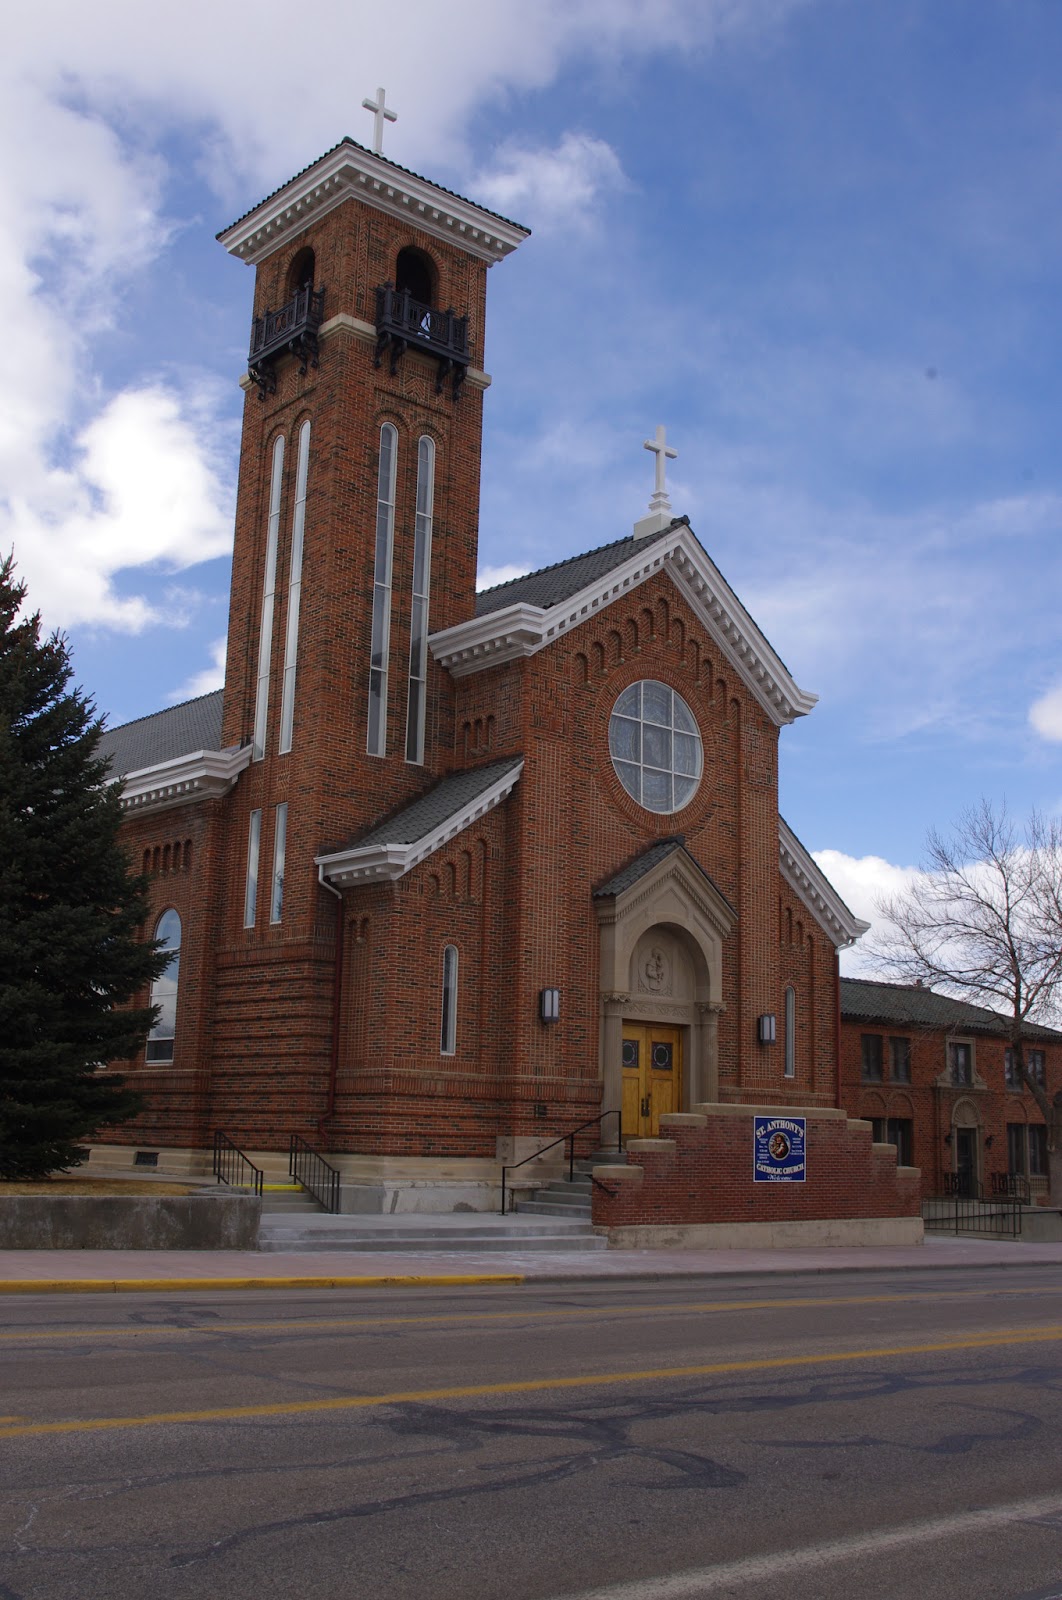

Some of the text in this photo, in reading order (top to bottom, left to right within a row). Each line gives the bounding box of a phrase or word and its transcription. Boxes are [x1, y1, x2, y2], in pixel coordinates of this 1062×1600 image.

[756, 1120, 804, 1138] ST. ANTHONY'S
[757, 1163, 804, 1174] CATHOLIC CHURCH
